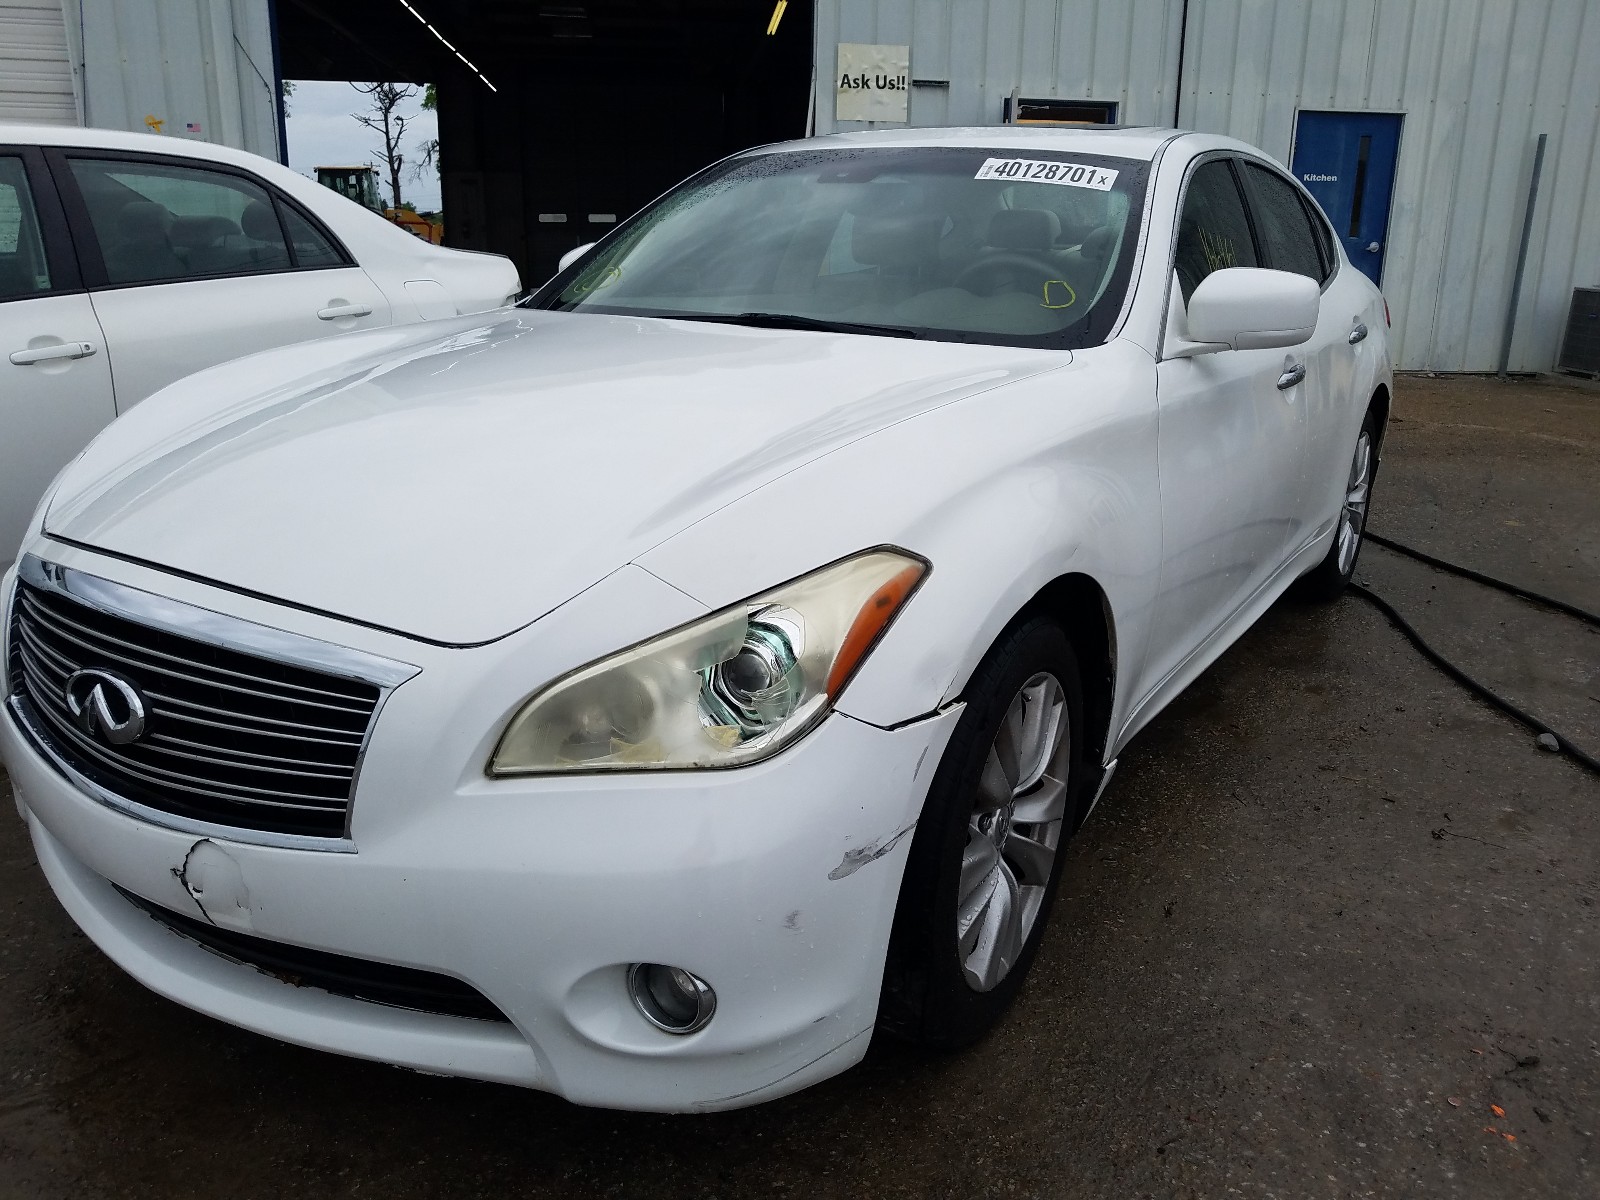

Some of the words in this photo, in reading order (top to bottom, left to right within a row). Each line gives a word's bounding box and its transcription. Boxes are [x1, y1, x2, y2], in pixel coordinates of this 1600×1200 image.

[840, 73, 871, 90] Ask
[875, 74, 906, 91] Us!!
[1303, 173, 1338, 182] Kitchen
